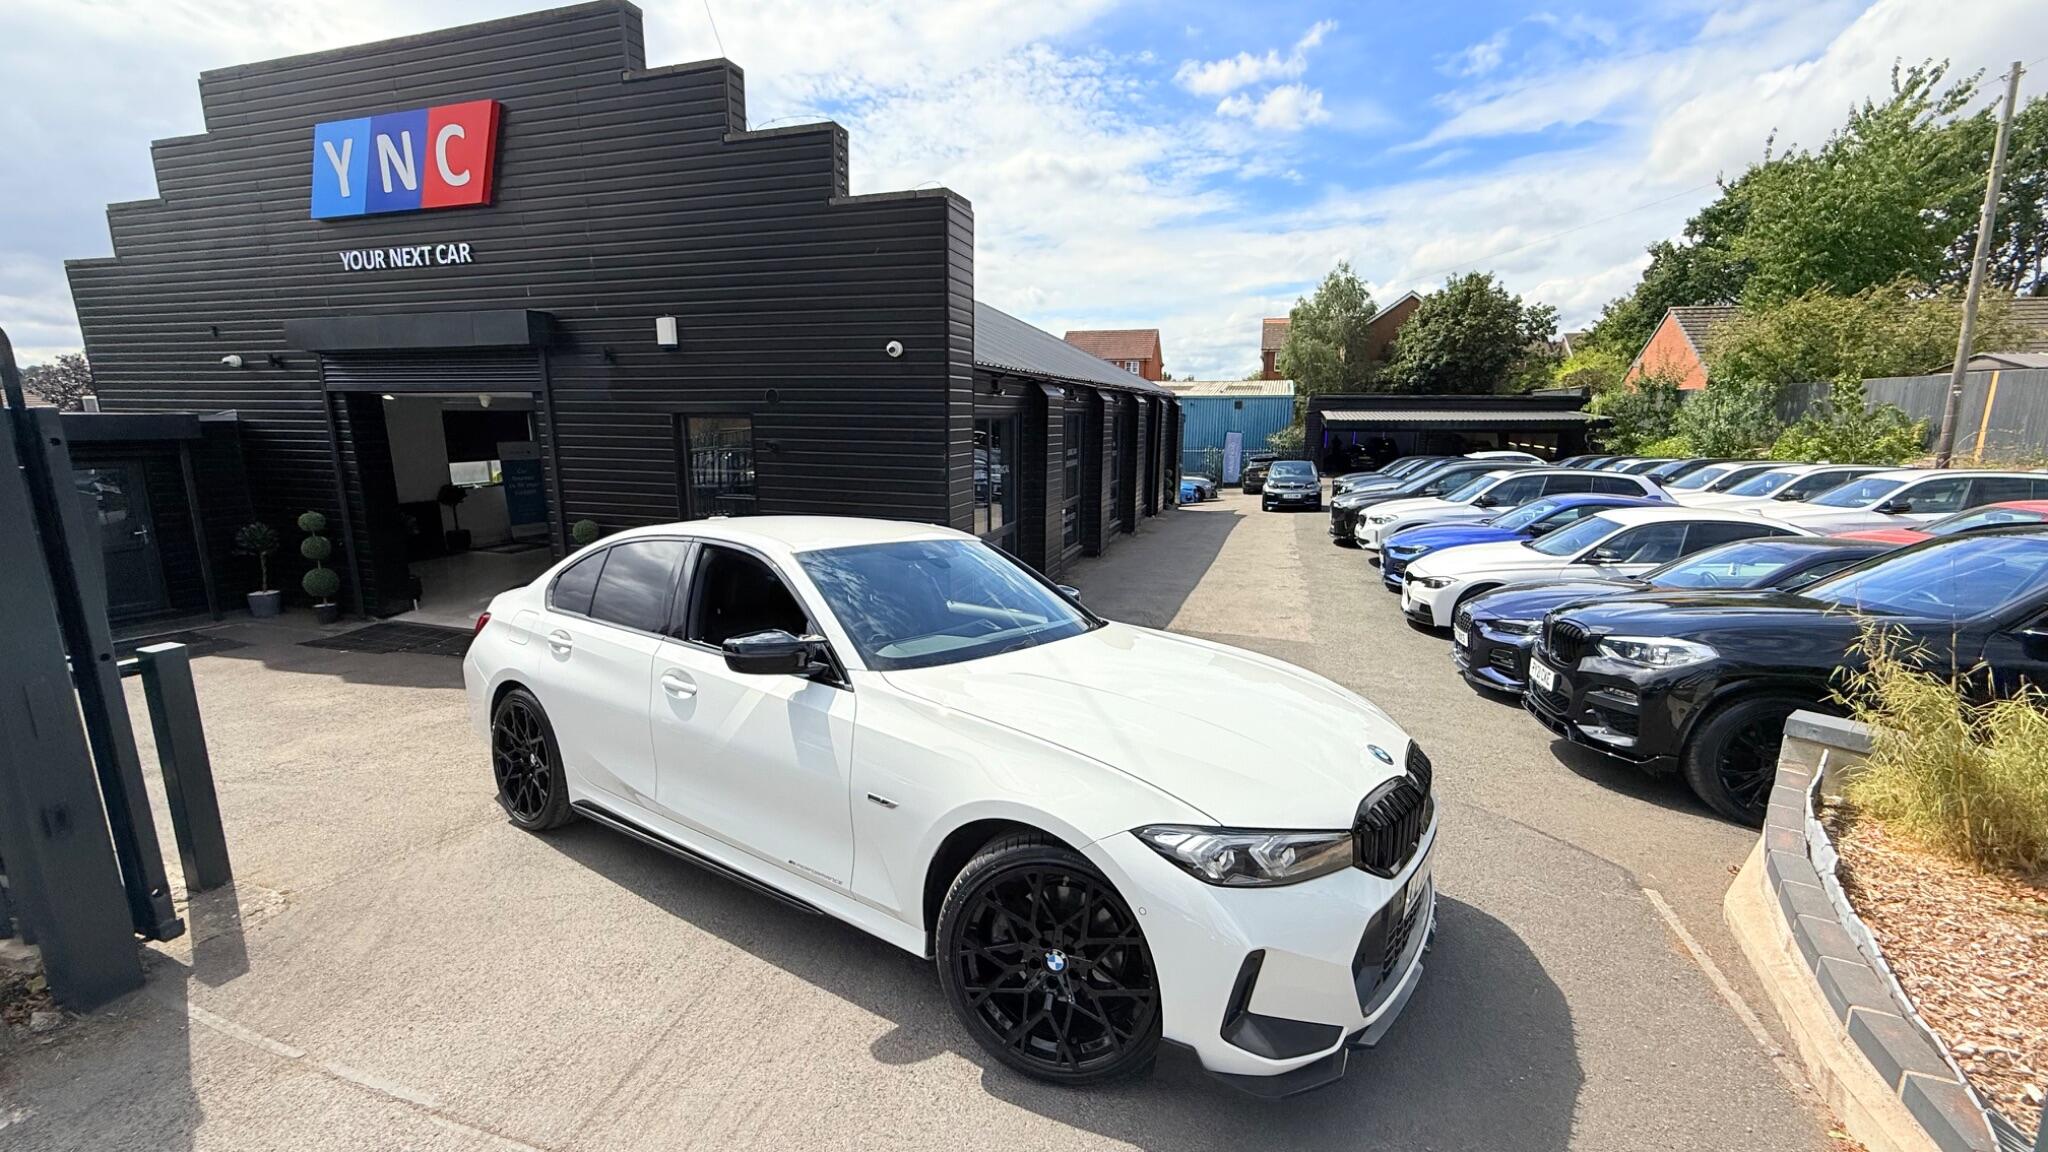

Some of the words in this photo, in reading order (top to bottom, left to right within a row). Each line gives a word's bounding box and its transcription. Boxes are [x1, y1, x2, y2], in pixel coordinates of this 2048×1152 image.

[322, 123, 471, 198] YNC
[339, 249, 387, 271] YOUR
[388, 245, 432, 268] NEXT
[435, 242, 473, 265] CAR
